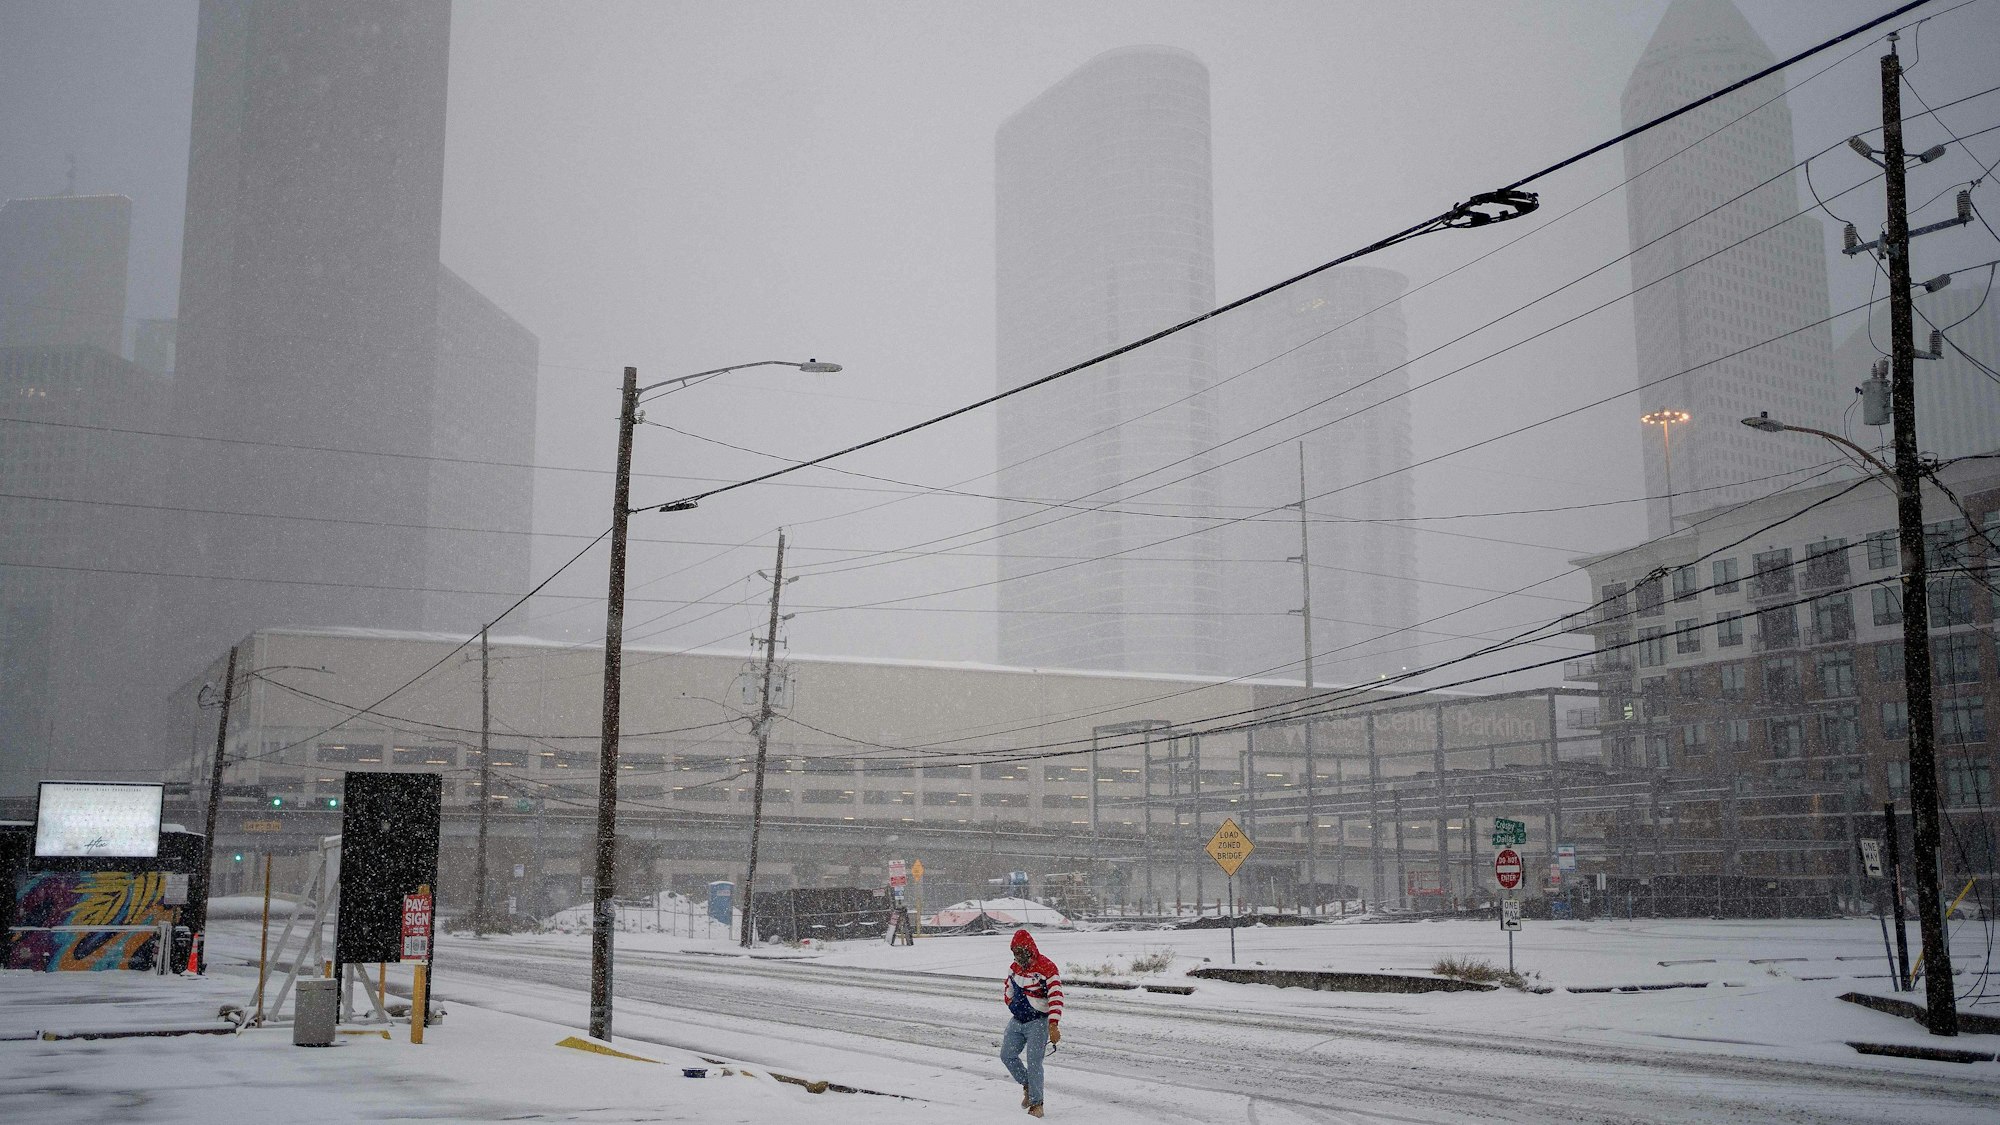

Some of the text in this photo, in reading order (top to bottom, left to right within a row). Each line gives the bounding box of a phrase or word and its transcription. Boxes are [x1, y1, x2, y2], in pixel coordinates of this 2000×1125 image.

[1458, 709, 1536, 739] Parking
[1219, 831, 1239, 839] LOAD
[1218, 841, 1241, 849] ZONED
[1864, 842, 1876, 851] ONE
[1217, 851, 1243, 860] BRIDGE
[1866, 853, 1878, 862] WAY
[405, 898, 424, 911] PAY
[1504, 901, 1518, 909] ONE
[405, 912, 429, 926] SIGN
[1504, 910, 1518, 919] WAY
